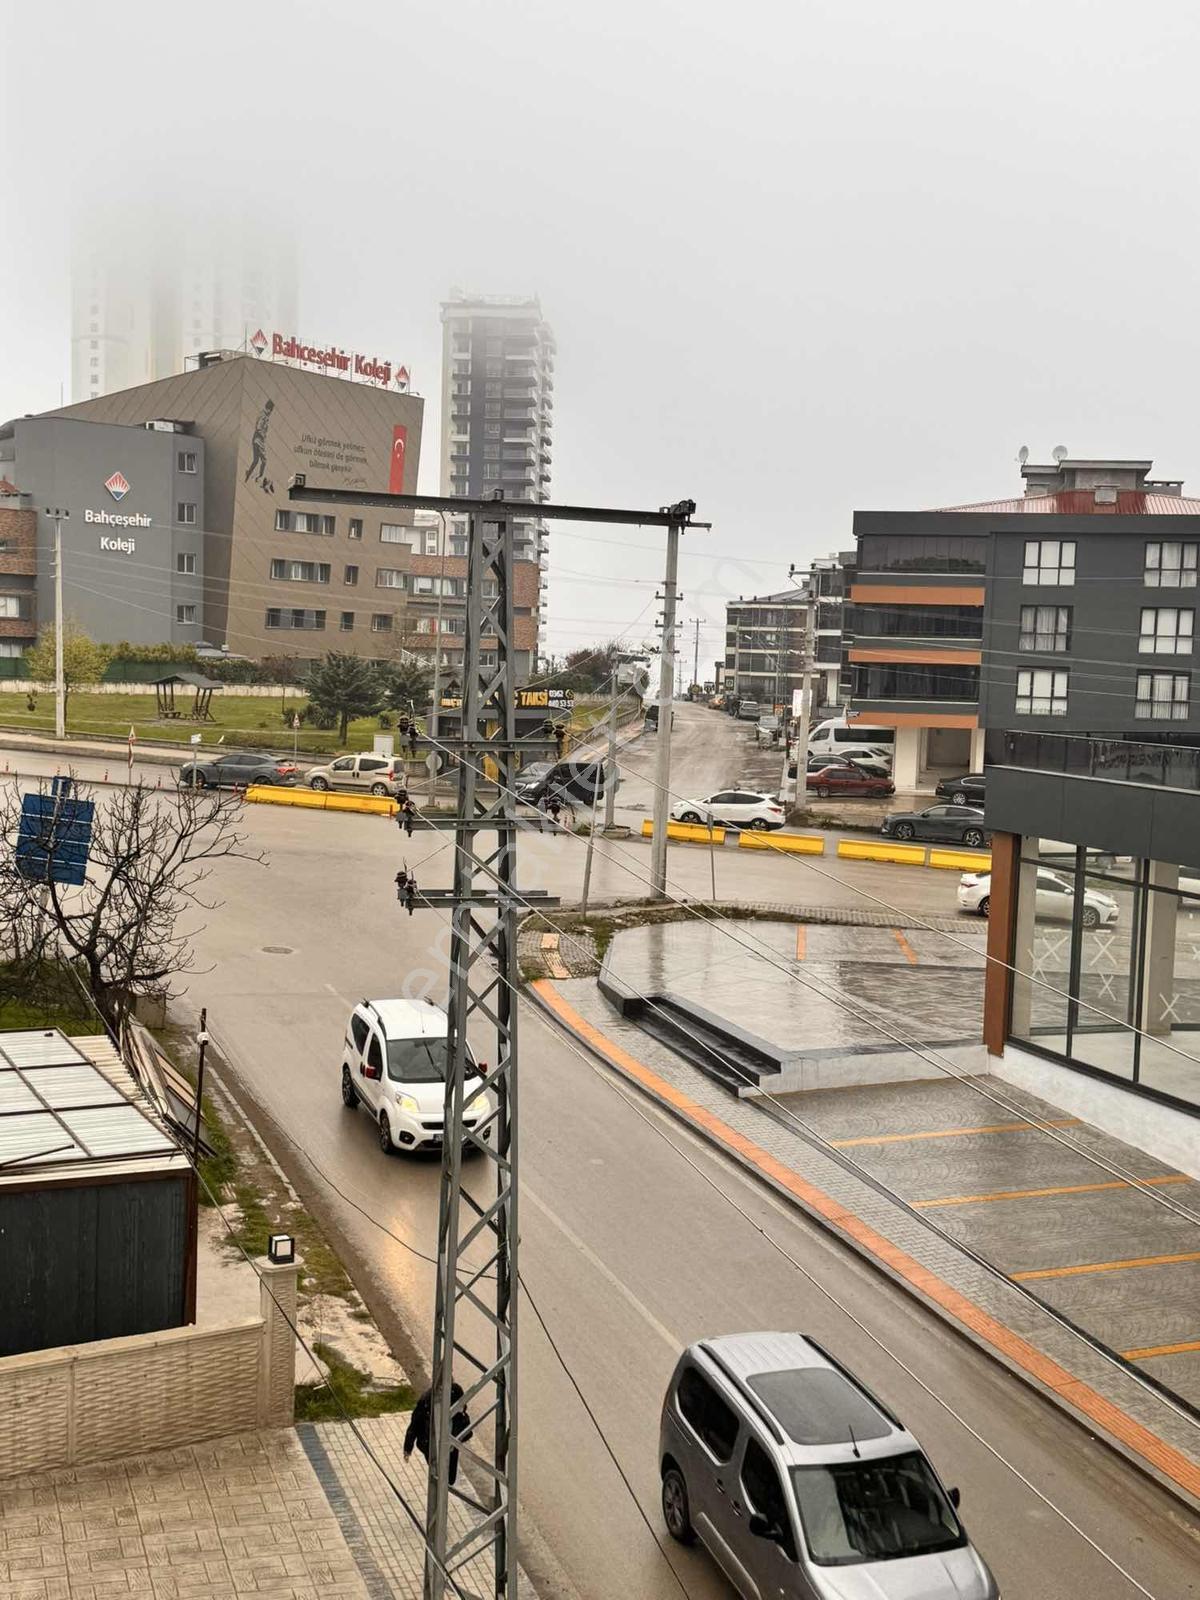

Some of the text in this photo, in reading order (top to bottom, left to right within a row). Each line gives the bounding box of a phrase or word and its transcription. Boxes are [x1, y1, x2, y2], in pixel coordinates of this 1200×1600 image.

[355, 354, 392, 385] Koleji
[84, 509, 152, 528] Bahçeşehir
[100, 537, 136, 554] Koleji
